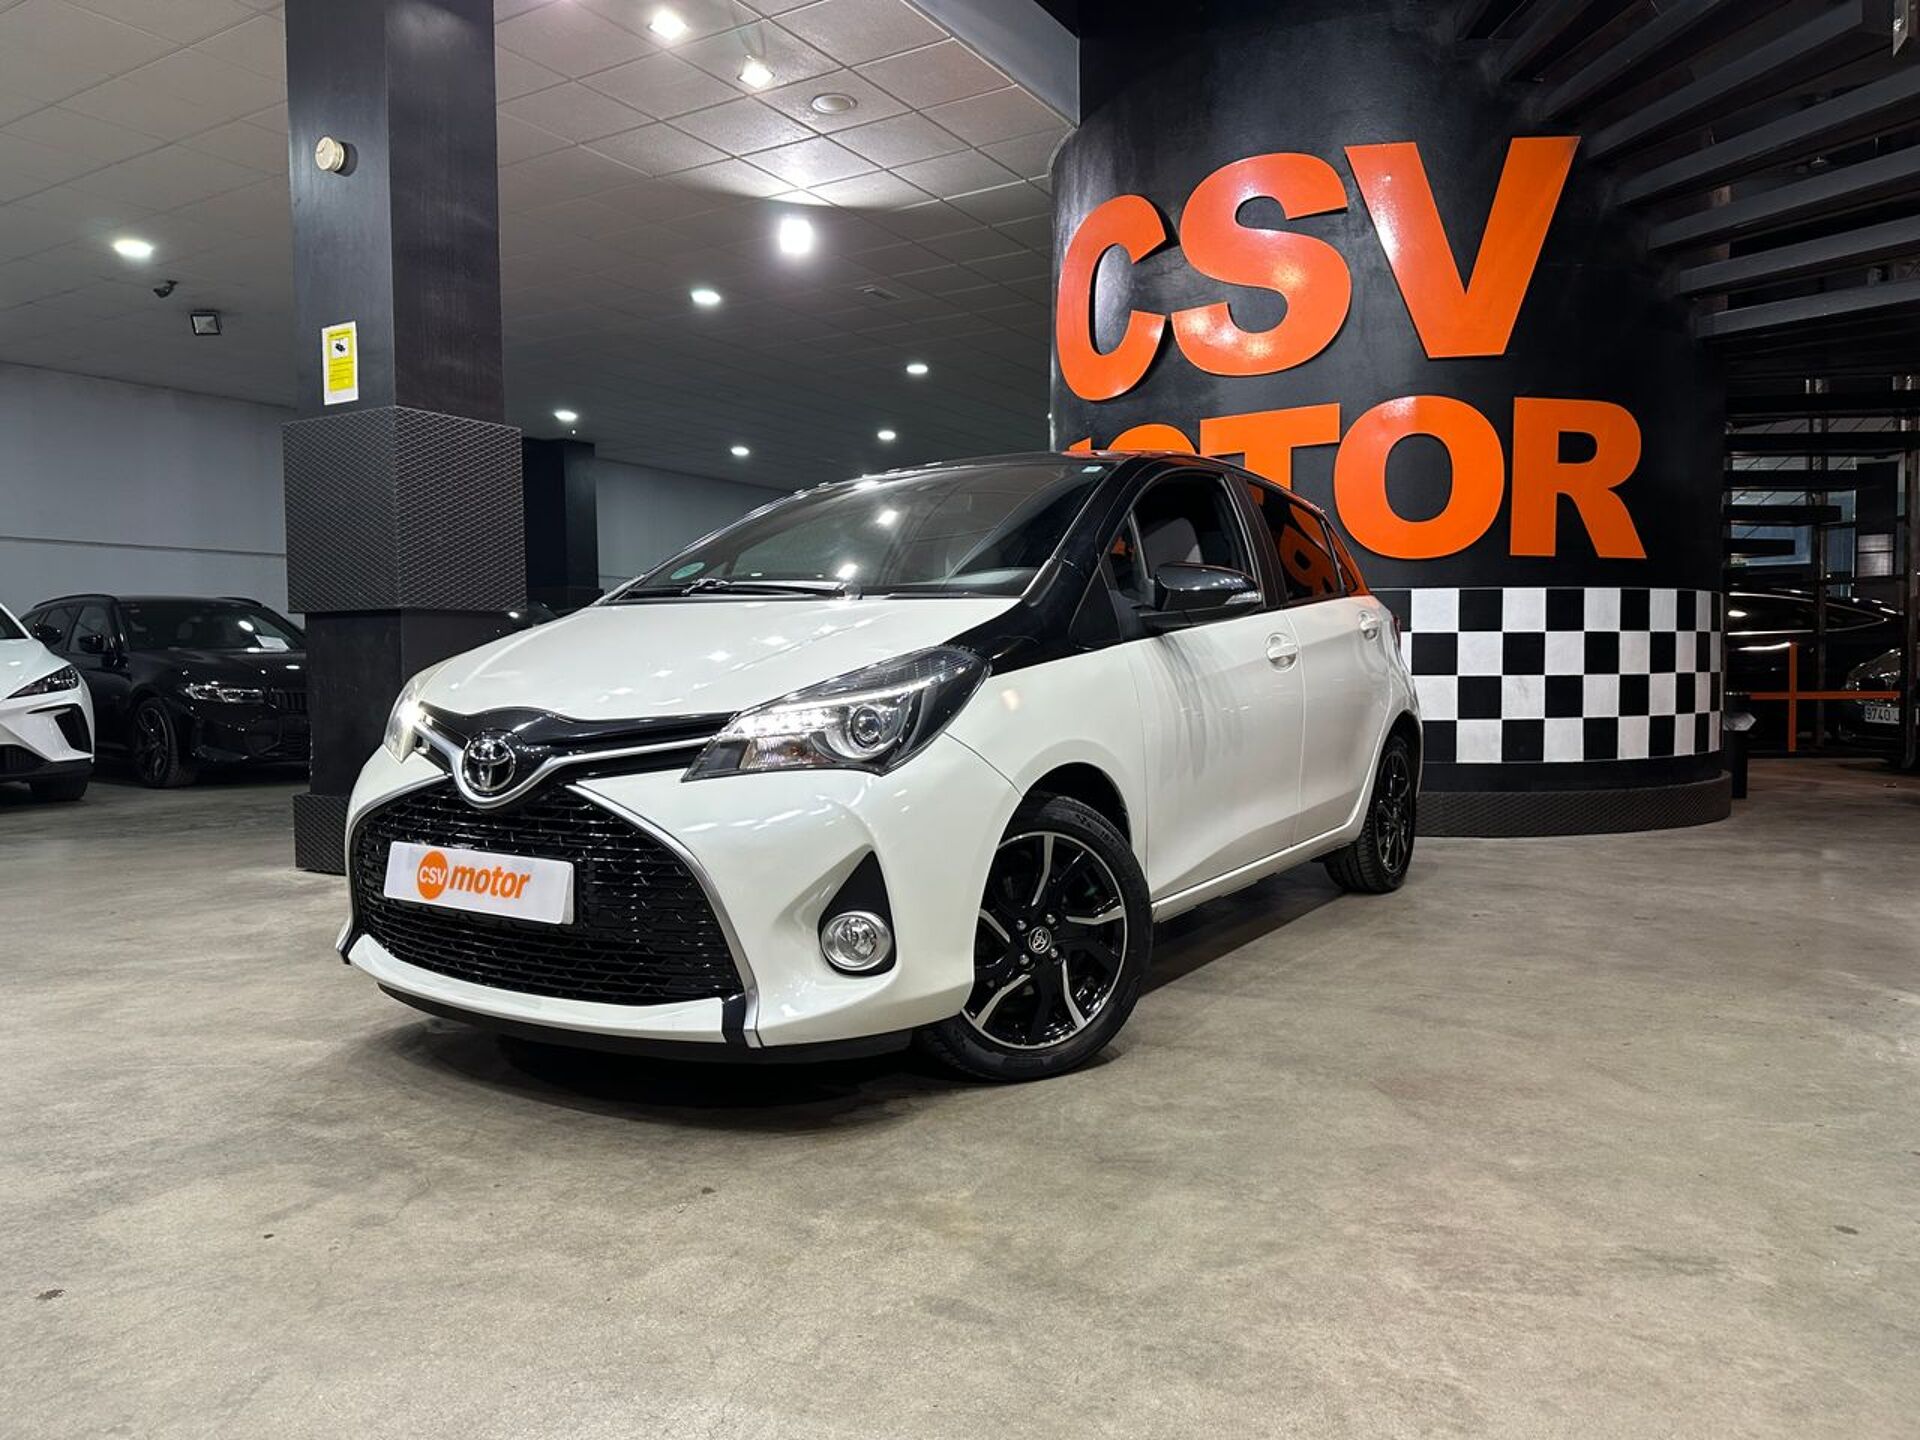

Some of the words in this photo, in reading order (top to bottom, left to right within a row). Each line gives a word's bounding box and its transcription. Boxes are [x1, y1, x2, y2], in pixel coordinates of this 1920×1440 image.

[1056, 136, 1579, 401] CSV
[1069, 395, 1646, 559] TOR
[419, 866, 447, 885] CSV
[449, 865, 530, 898] motor
